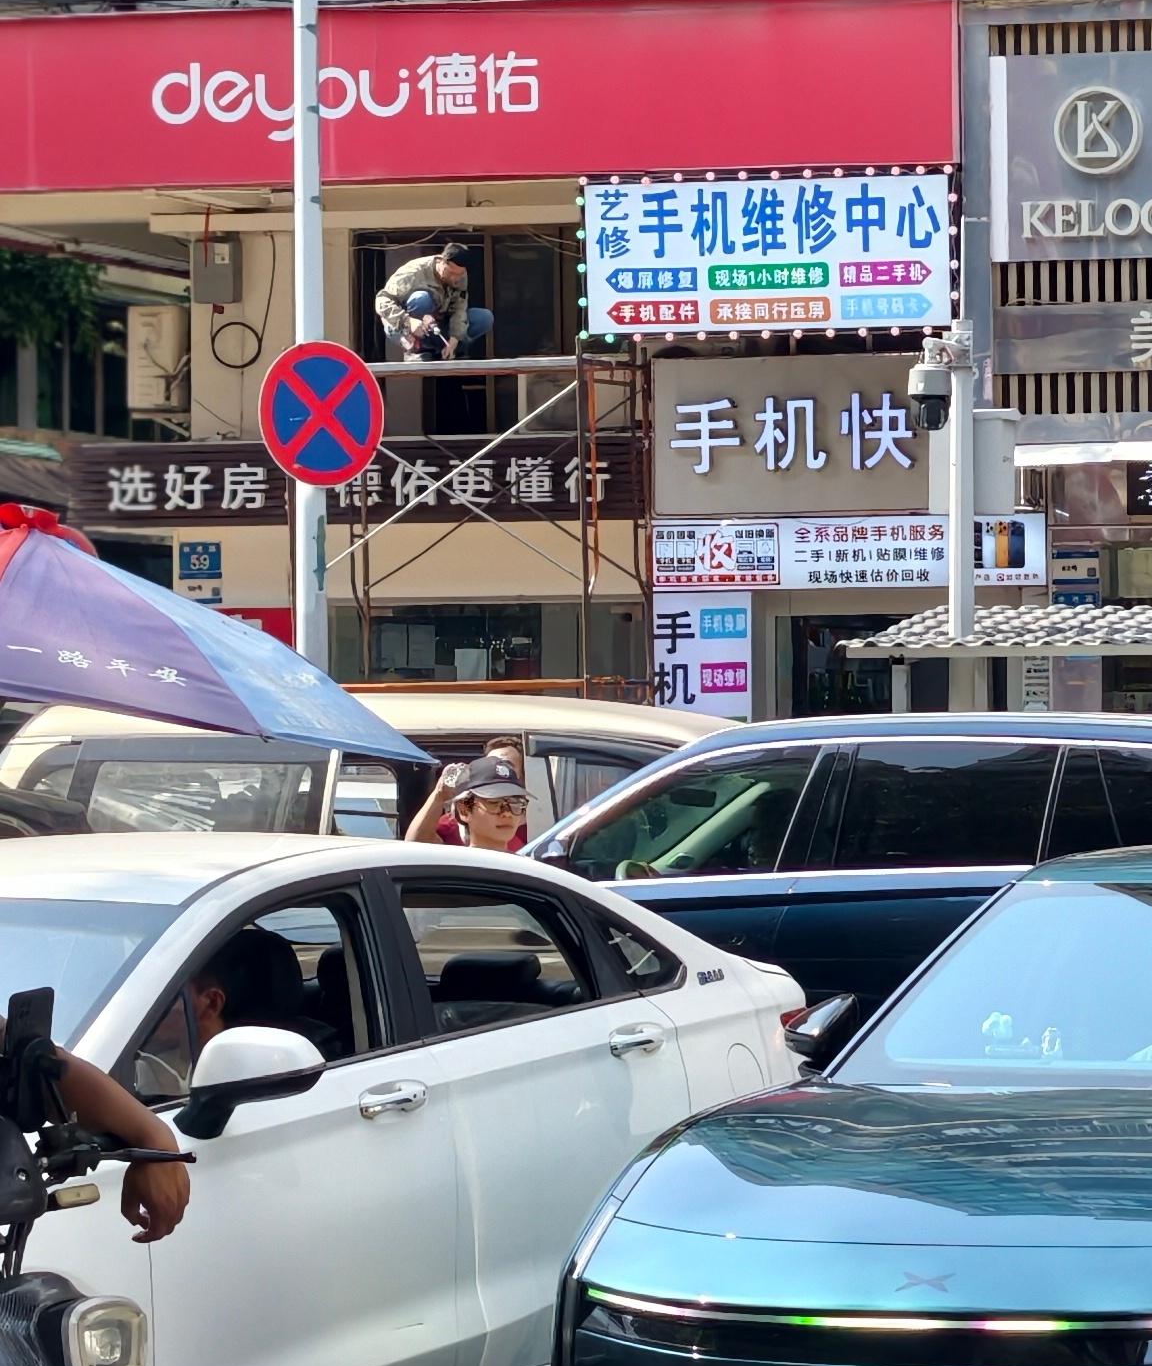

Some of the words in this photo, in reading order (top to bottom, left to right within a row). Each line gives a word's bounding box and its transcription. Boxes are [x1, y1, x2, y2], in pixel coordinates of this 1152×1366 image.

[416, 50, 539, 116] 德佑
[638, 182, 942, 259] 手机维修中心
[618, 302, 696, 323] 手机配件
[108, 462, 270, 512] 选好房
[794, 524, 945, 543] 全系品牌手机服务
[807, 568, 931, 584] 现场快速估价回收
